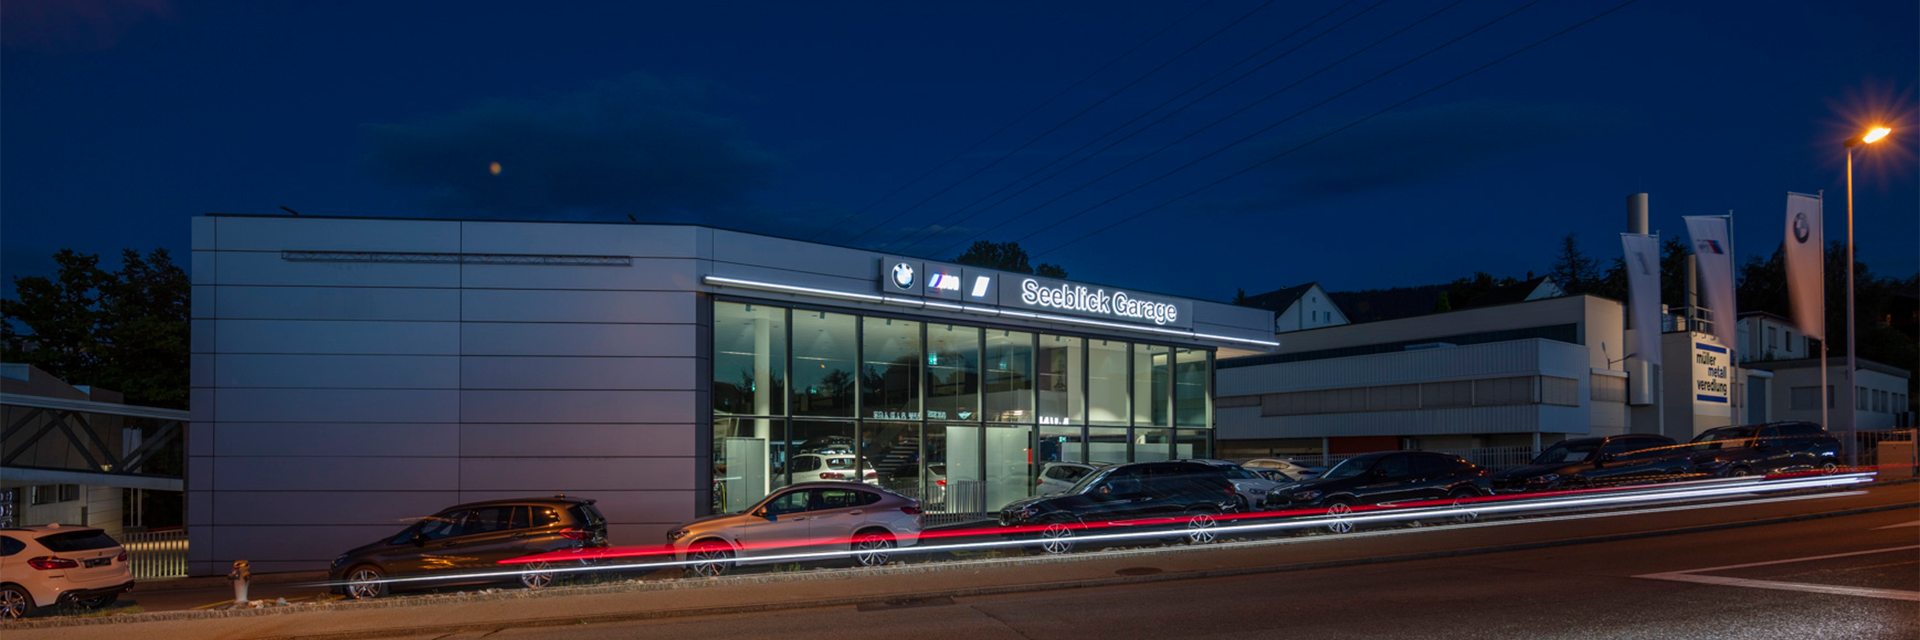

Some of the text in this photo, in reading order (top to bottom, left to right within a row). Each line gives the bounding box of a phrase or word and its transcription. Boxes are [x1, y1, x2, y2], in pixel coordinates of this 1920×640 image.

[1022, 279, 1177, 324] Seeblick Garage
[1696, 351, 1716, 365] müller
[1708, 366, 1727, 378] metall
[1697, 379, 1727, 396] veredlung
